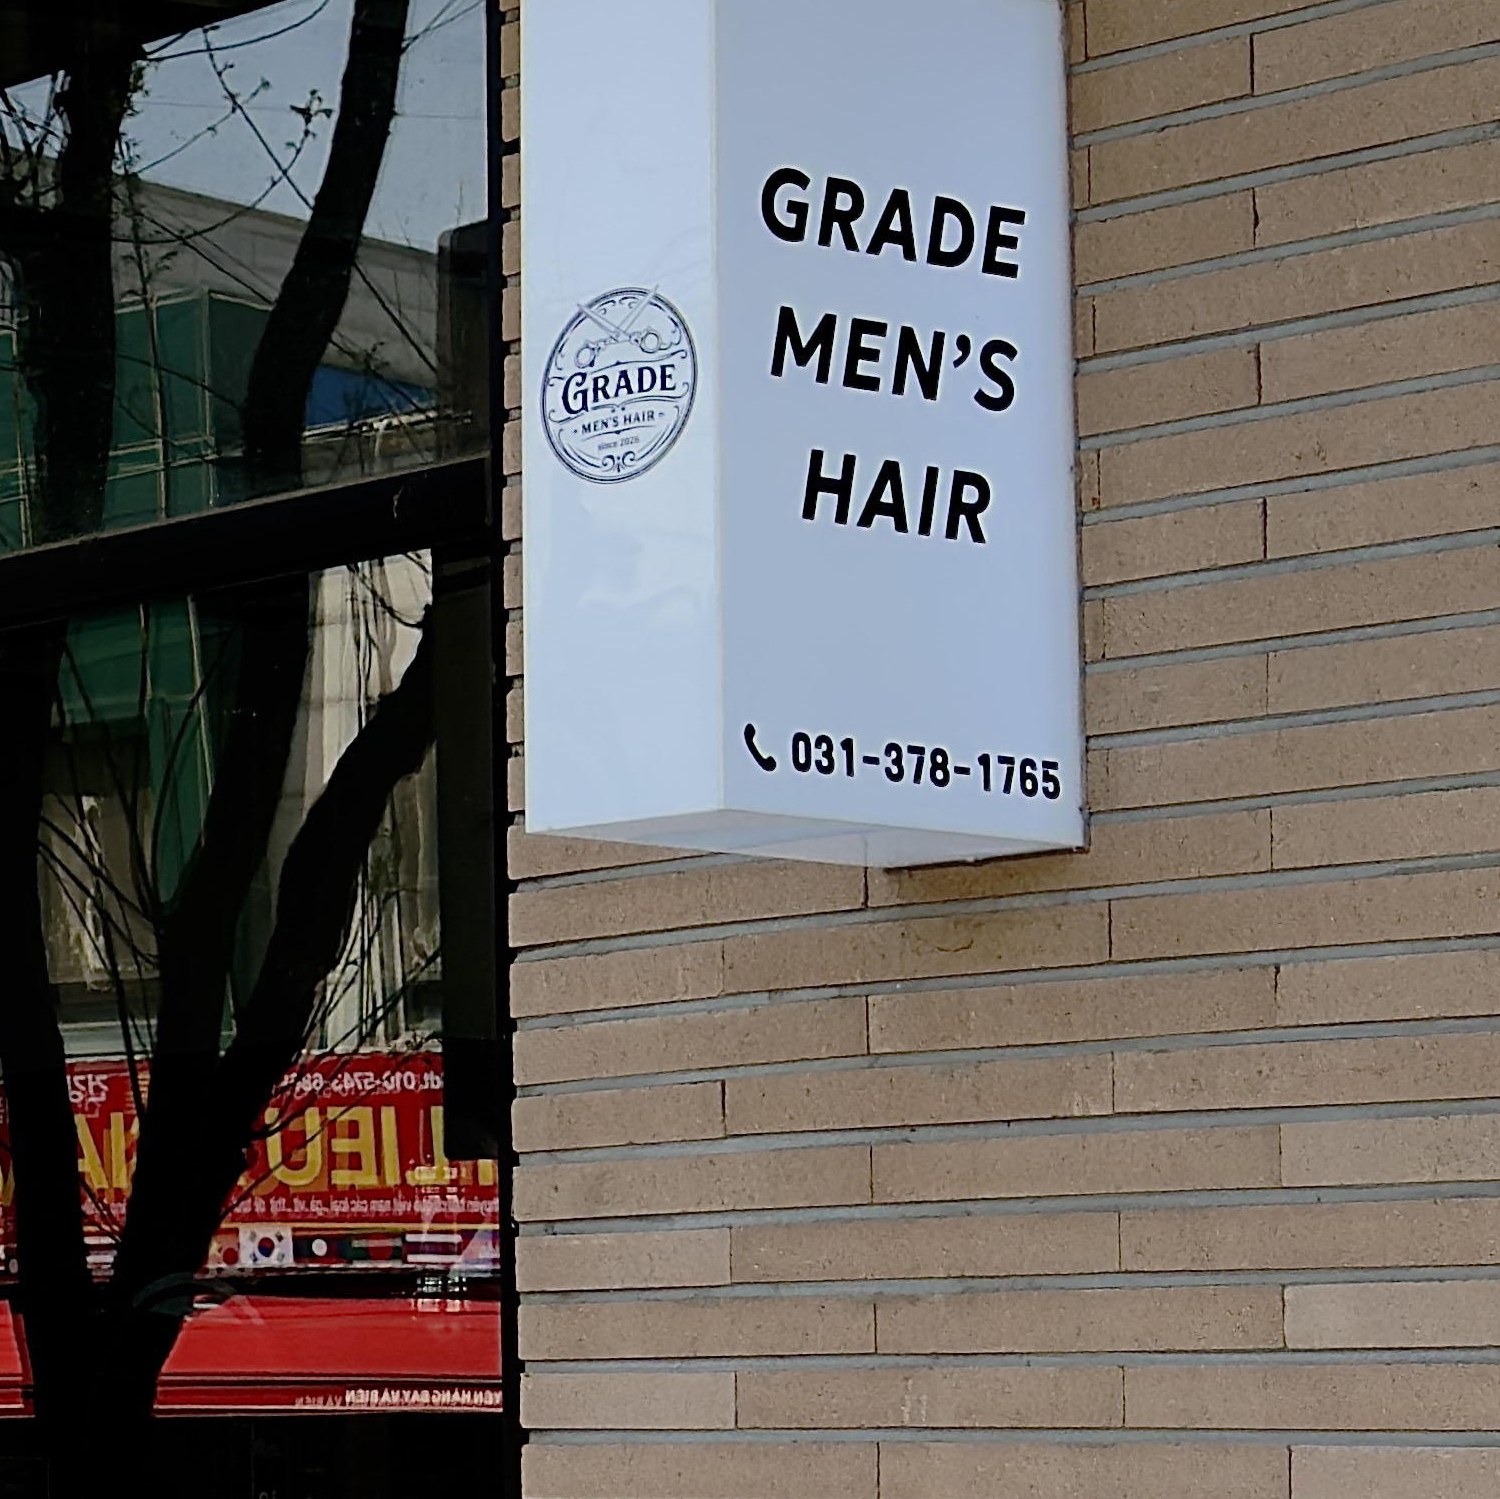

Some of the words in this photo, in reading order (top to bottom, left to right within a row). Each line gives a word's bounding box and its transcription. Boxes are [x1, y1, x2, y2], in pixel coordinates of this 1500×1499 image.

[760, 167, 1026, 279] GRADE
[561, 364, 676, 414] GRADE
[770, 305, 1020, 413] MEN'S
[581, 416, 619, 434] MEN'S
[623, 410, 656, 425] HAIR
[801, 448, 993, 545] HAIR
[791, 730, 1062, 800] 031-378-1765
